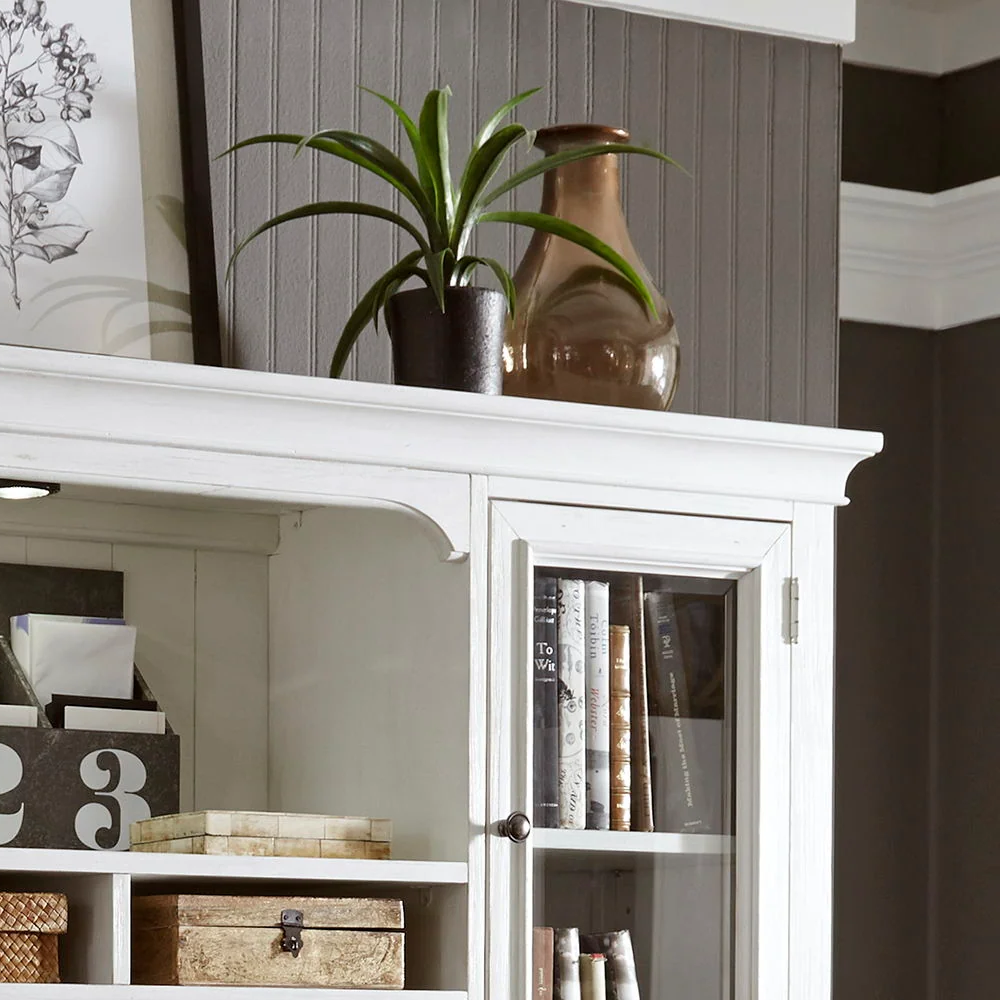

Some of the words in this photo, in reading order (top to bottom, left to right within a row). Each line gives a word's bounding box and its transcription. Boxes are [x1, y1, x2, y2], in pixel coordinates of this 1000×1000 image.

[536, 642, 554, 655] To
[535, 658, 556, 672] Wit
[589, 687, 601, 732] Webster
[669, 671, 681, 717] Marriage
[677, 729, 685, 753] Most
[680, 753, 688, 770] the
[74, 748, 152, 852] 3
[683, 770, 694, 808] Making
